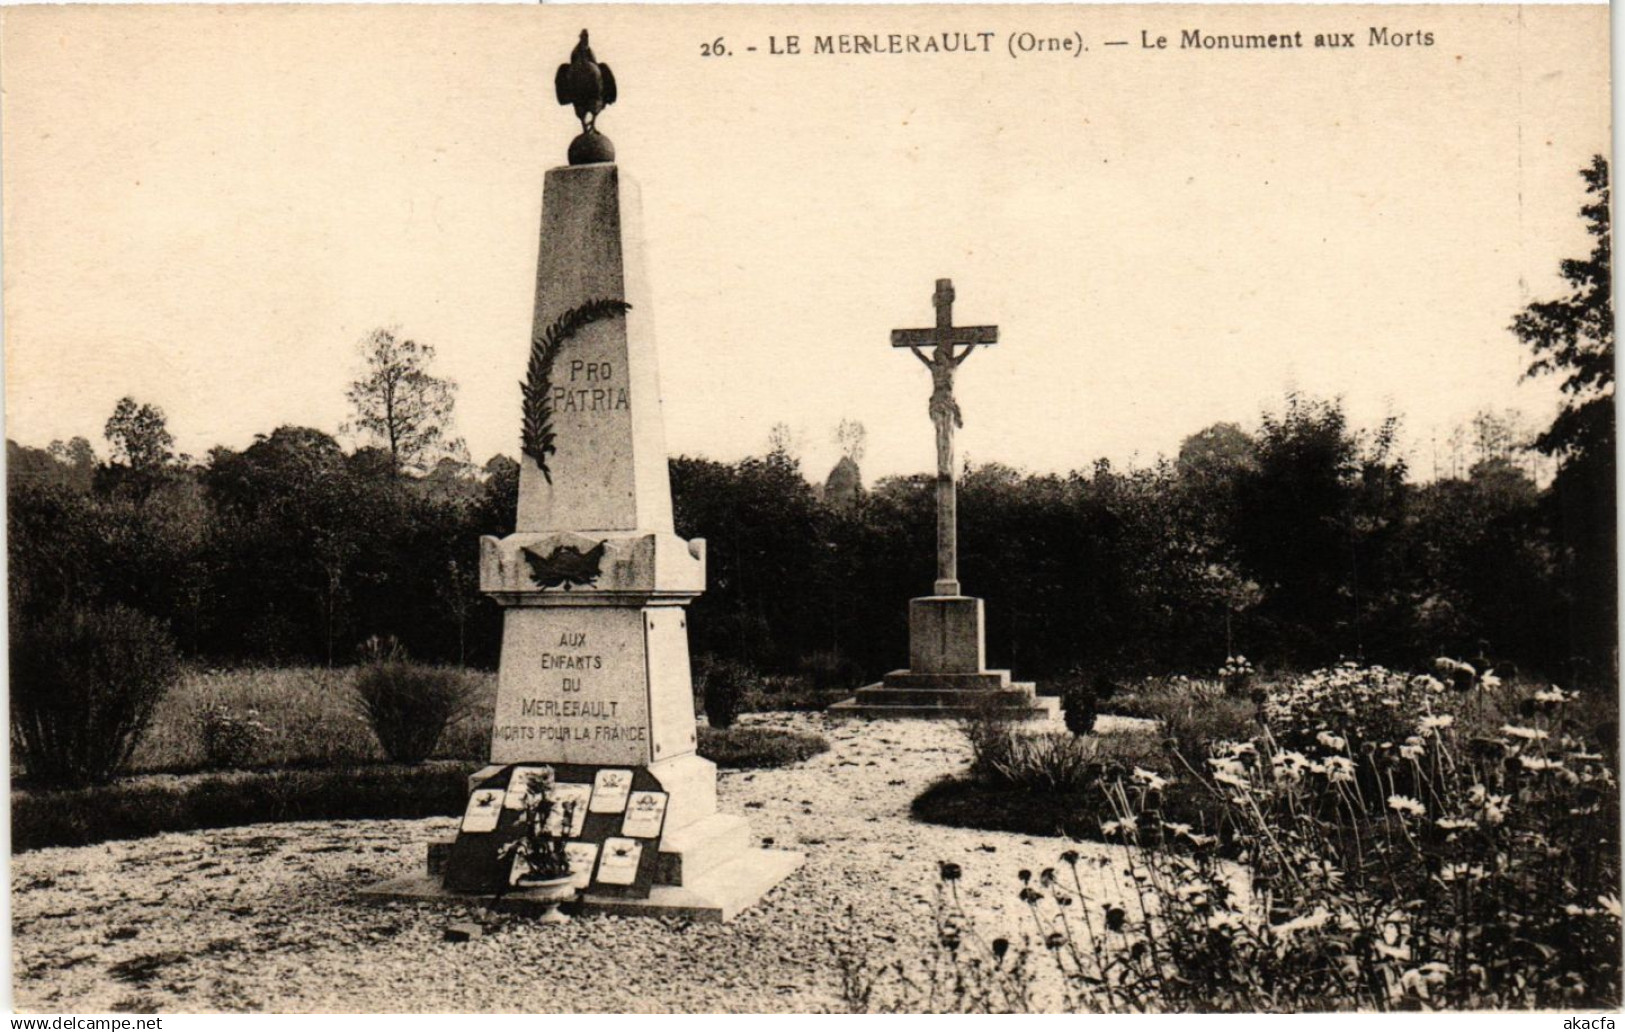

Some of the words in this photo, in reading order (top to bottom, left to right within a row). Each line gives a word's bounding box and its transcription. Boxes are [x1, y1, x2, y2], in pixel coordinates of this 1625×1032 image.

[570, 360, 612, 381] PRO
[553, 386, 630, 413] PATRIA
[559, 633, 586, 648] AUX
[541, 652, 603, 670] ENFANTS
[562, 677, 581, 693] DU
[521, 698, 618, 718] MERLERAULT
[493, 725, 535, 742] MORTS
[538, 725, 571, 741] POUR
[574, 725, 590, 740] LA
[594, 725, 646, 741] FRANCE
